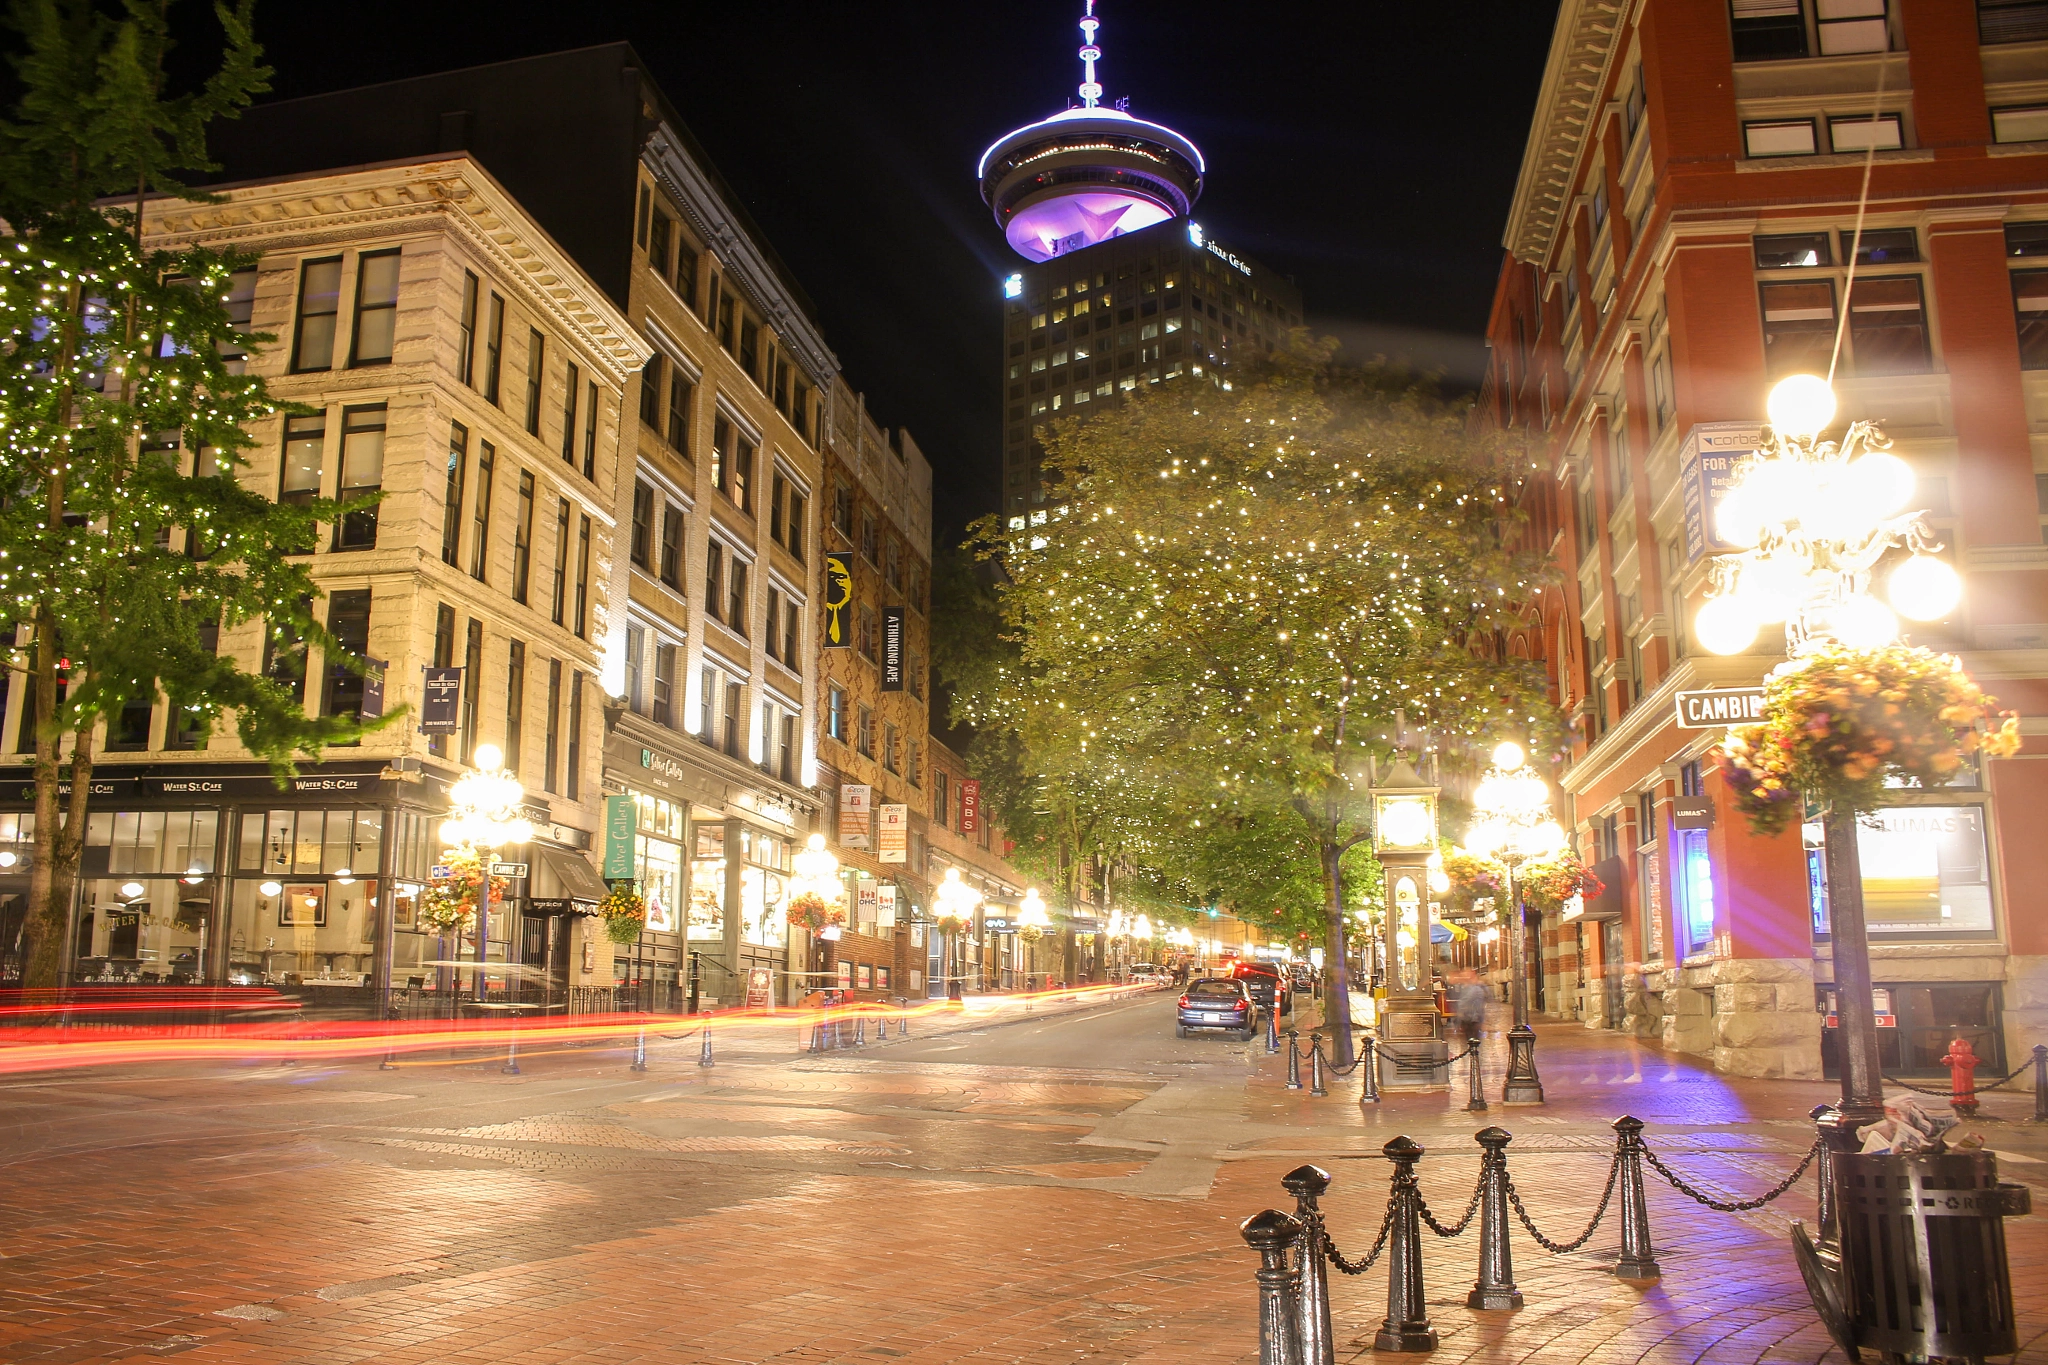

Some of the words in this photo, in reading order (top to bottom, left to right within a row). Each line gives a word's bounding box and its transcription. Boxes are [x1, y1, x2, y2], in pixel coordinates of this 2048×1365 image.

[1702, 457, 1727, 471] FOR
[887, 615, 900, 623] A
[887, 622, 899, 665] THINKING
[886, 665, 899, 683] APE
[1688, 695, 1763, 721] CAMBIE
[665, 759, 683, 781] Gallery
[163, 782, 188, 792] WATER
[295, 780, 322, 790] WATER
[611, 800, 630, 841] Gallery
[964, 796, 975, 830] SBS
[611, 844, 628, 874] Silver
[98, 915, 135, 932] WATER
[162, 917, 190, 935] CAFE
[985, 919, 1006, 928] evo
